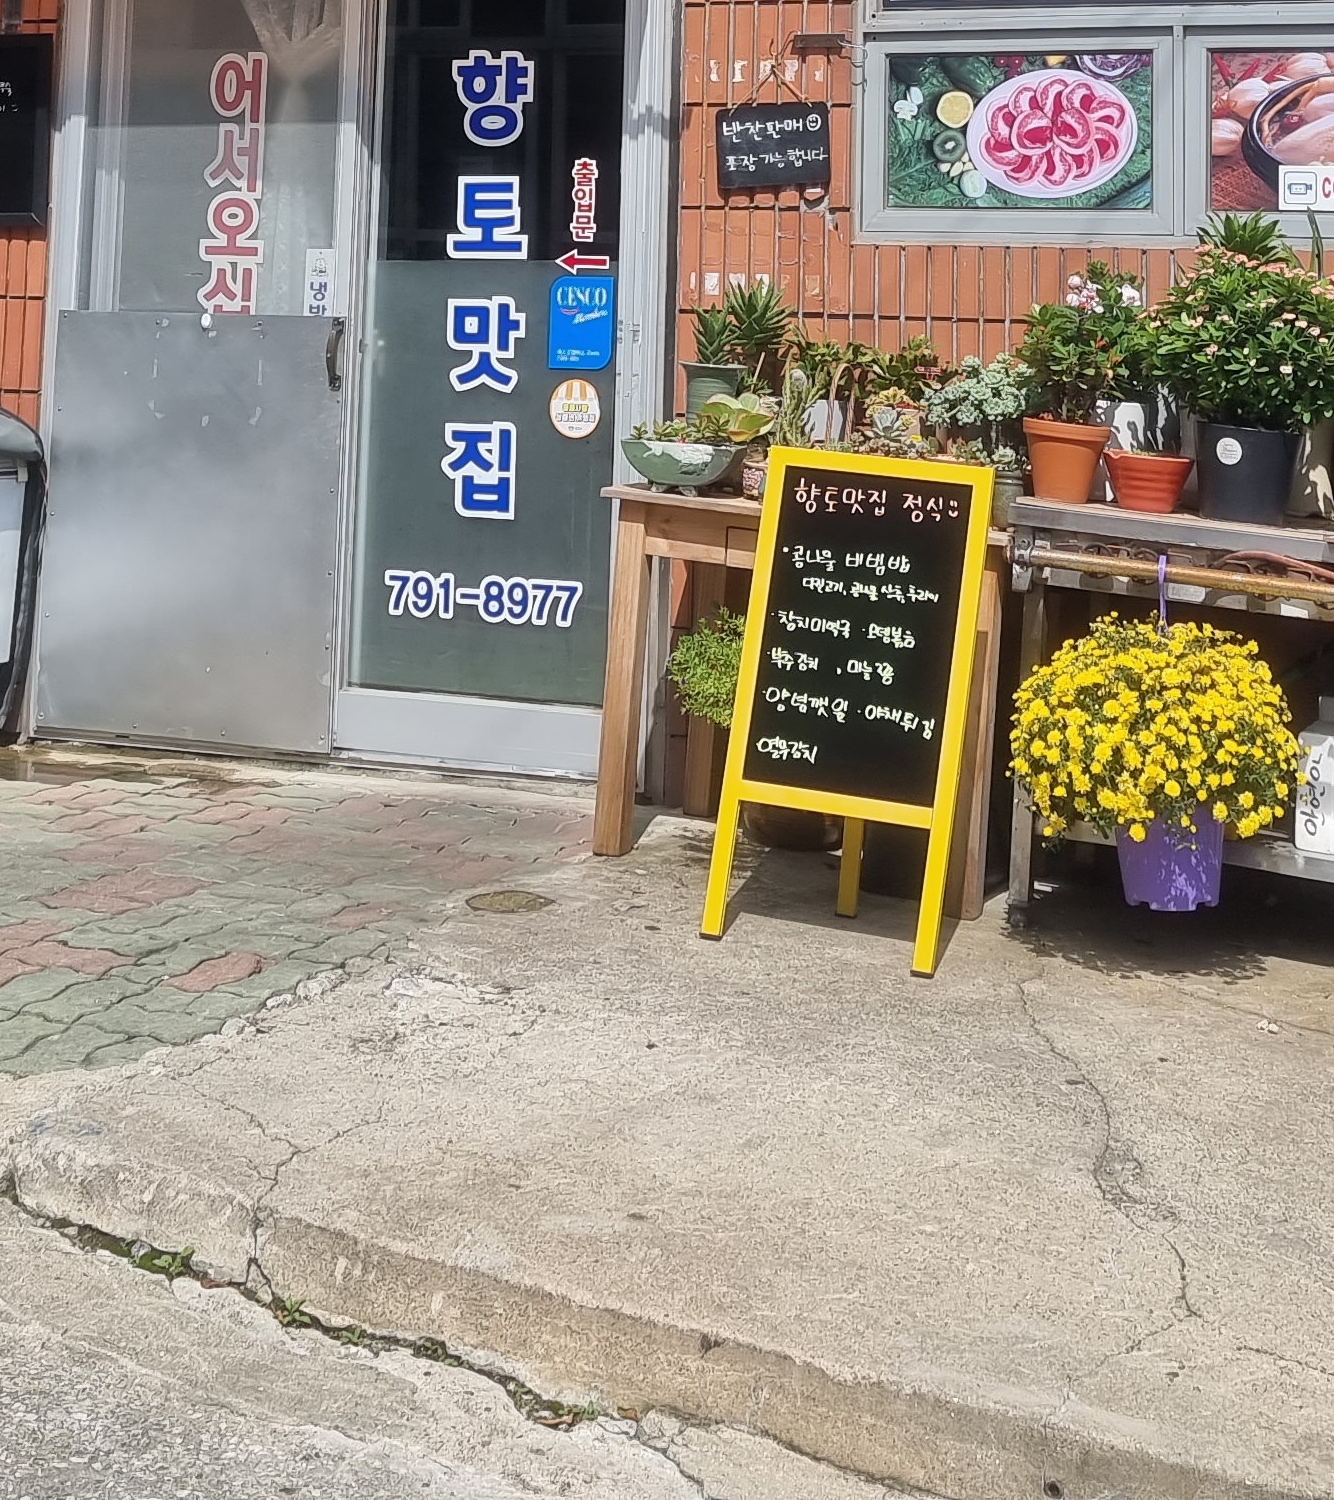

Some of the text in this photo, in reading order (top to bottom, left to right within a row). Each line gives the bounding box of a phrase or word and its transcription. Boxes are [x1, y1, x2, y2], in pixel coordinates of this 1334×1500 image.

[722, 117, 804, 143] 반찬판매
[570, 157, 598, 242] 출입문
[441, 49, 535, 519] 향토맛집
[556, 286, 608, 306] CESCO
[794, 477, 945, 523] 향토맛집 정식
[385, 569, 583, 627] 791-8977
